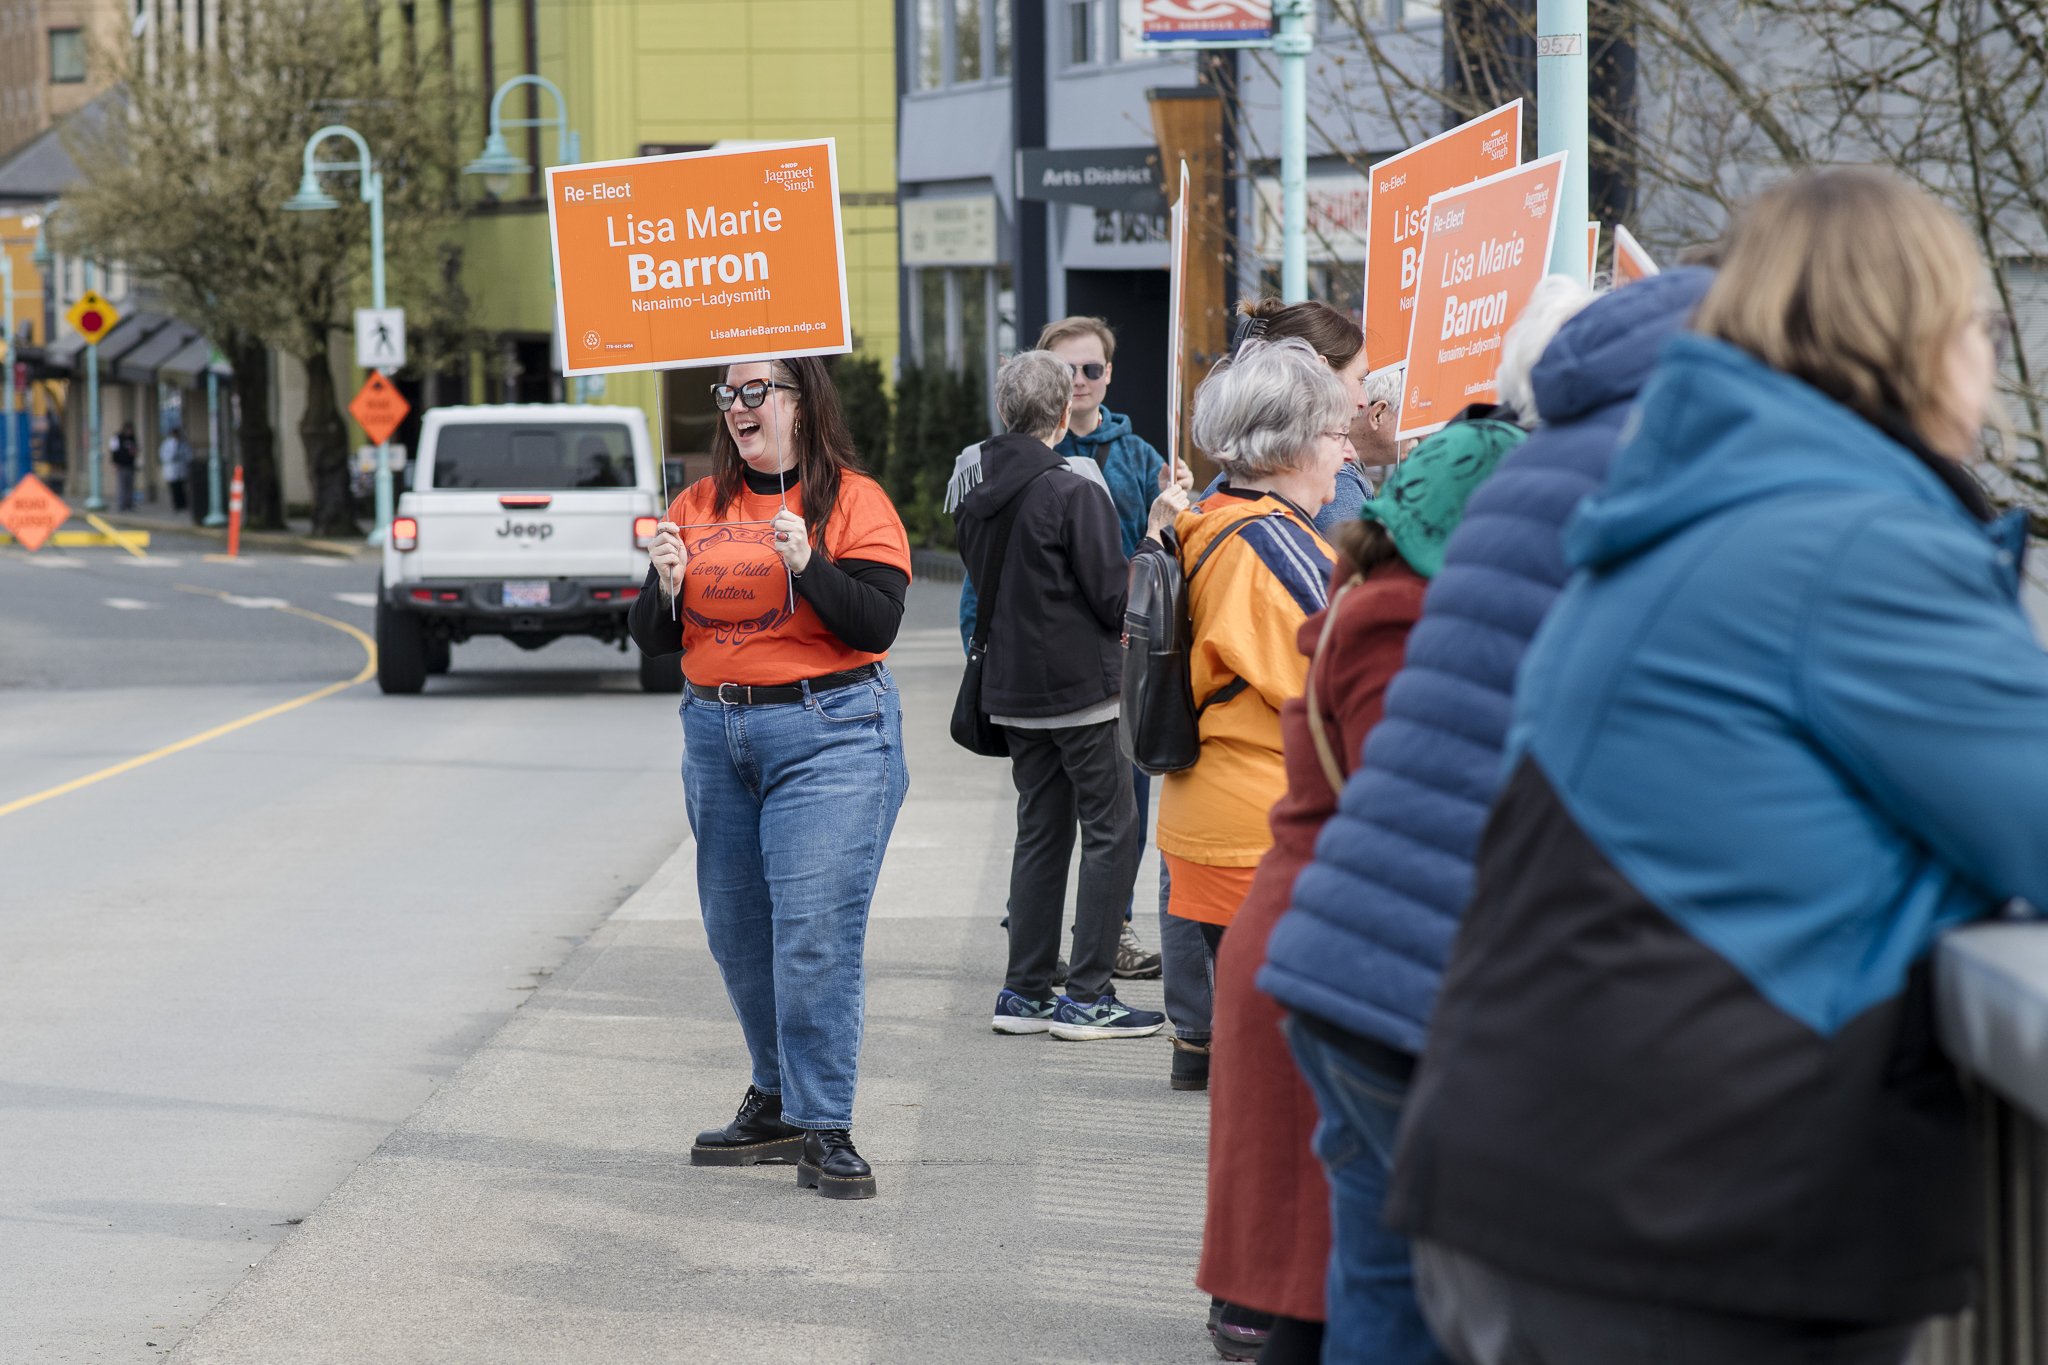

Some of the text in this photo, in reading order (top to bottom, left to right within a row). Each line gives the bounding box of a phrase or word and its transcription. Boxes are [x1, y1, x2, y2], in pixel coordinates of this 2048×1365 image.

[1481, 131, 1508, 156] Jagmeet
[1491, 144, 1508, 160] Singh
[764, 166, 813, 184] Jagmeet
[784, 178, 815, 193] Singh
[1042, 164, 1152, 187] Arts District
[1380, 172, 1406, 194] Re-Elect
[564, 182, 632, 202] Re-Elect
[607, 201, 783, 248] Lisa Marie
[1432, 208, 1464, 234] Re-Elect
[1440, 249, 1475, 288] Lisa
[1476, 230, 1524, 278] Marie
[628, 250, 769, 292] Barron
[1440, 288, 1508, 342] Barron
[710, 320, 826, 340] LisaMarieBarron.ndp.ca
[496, 520, 553, 540] Jeep
[692, 562, 773, 582] Every Child
[702, 584, 756, 600] Matters
